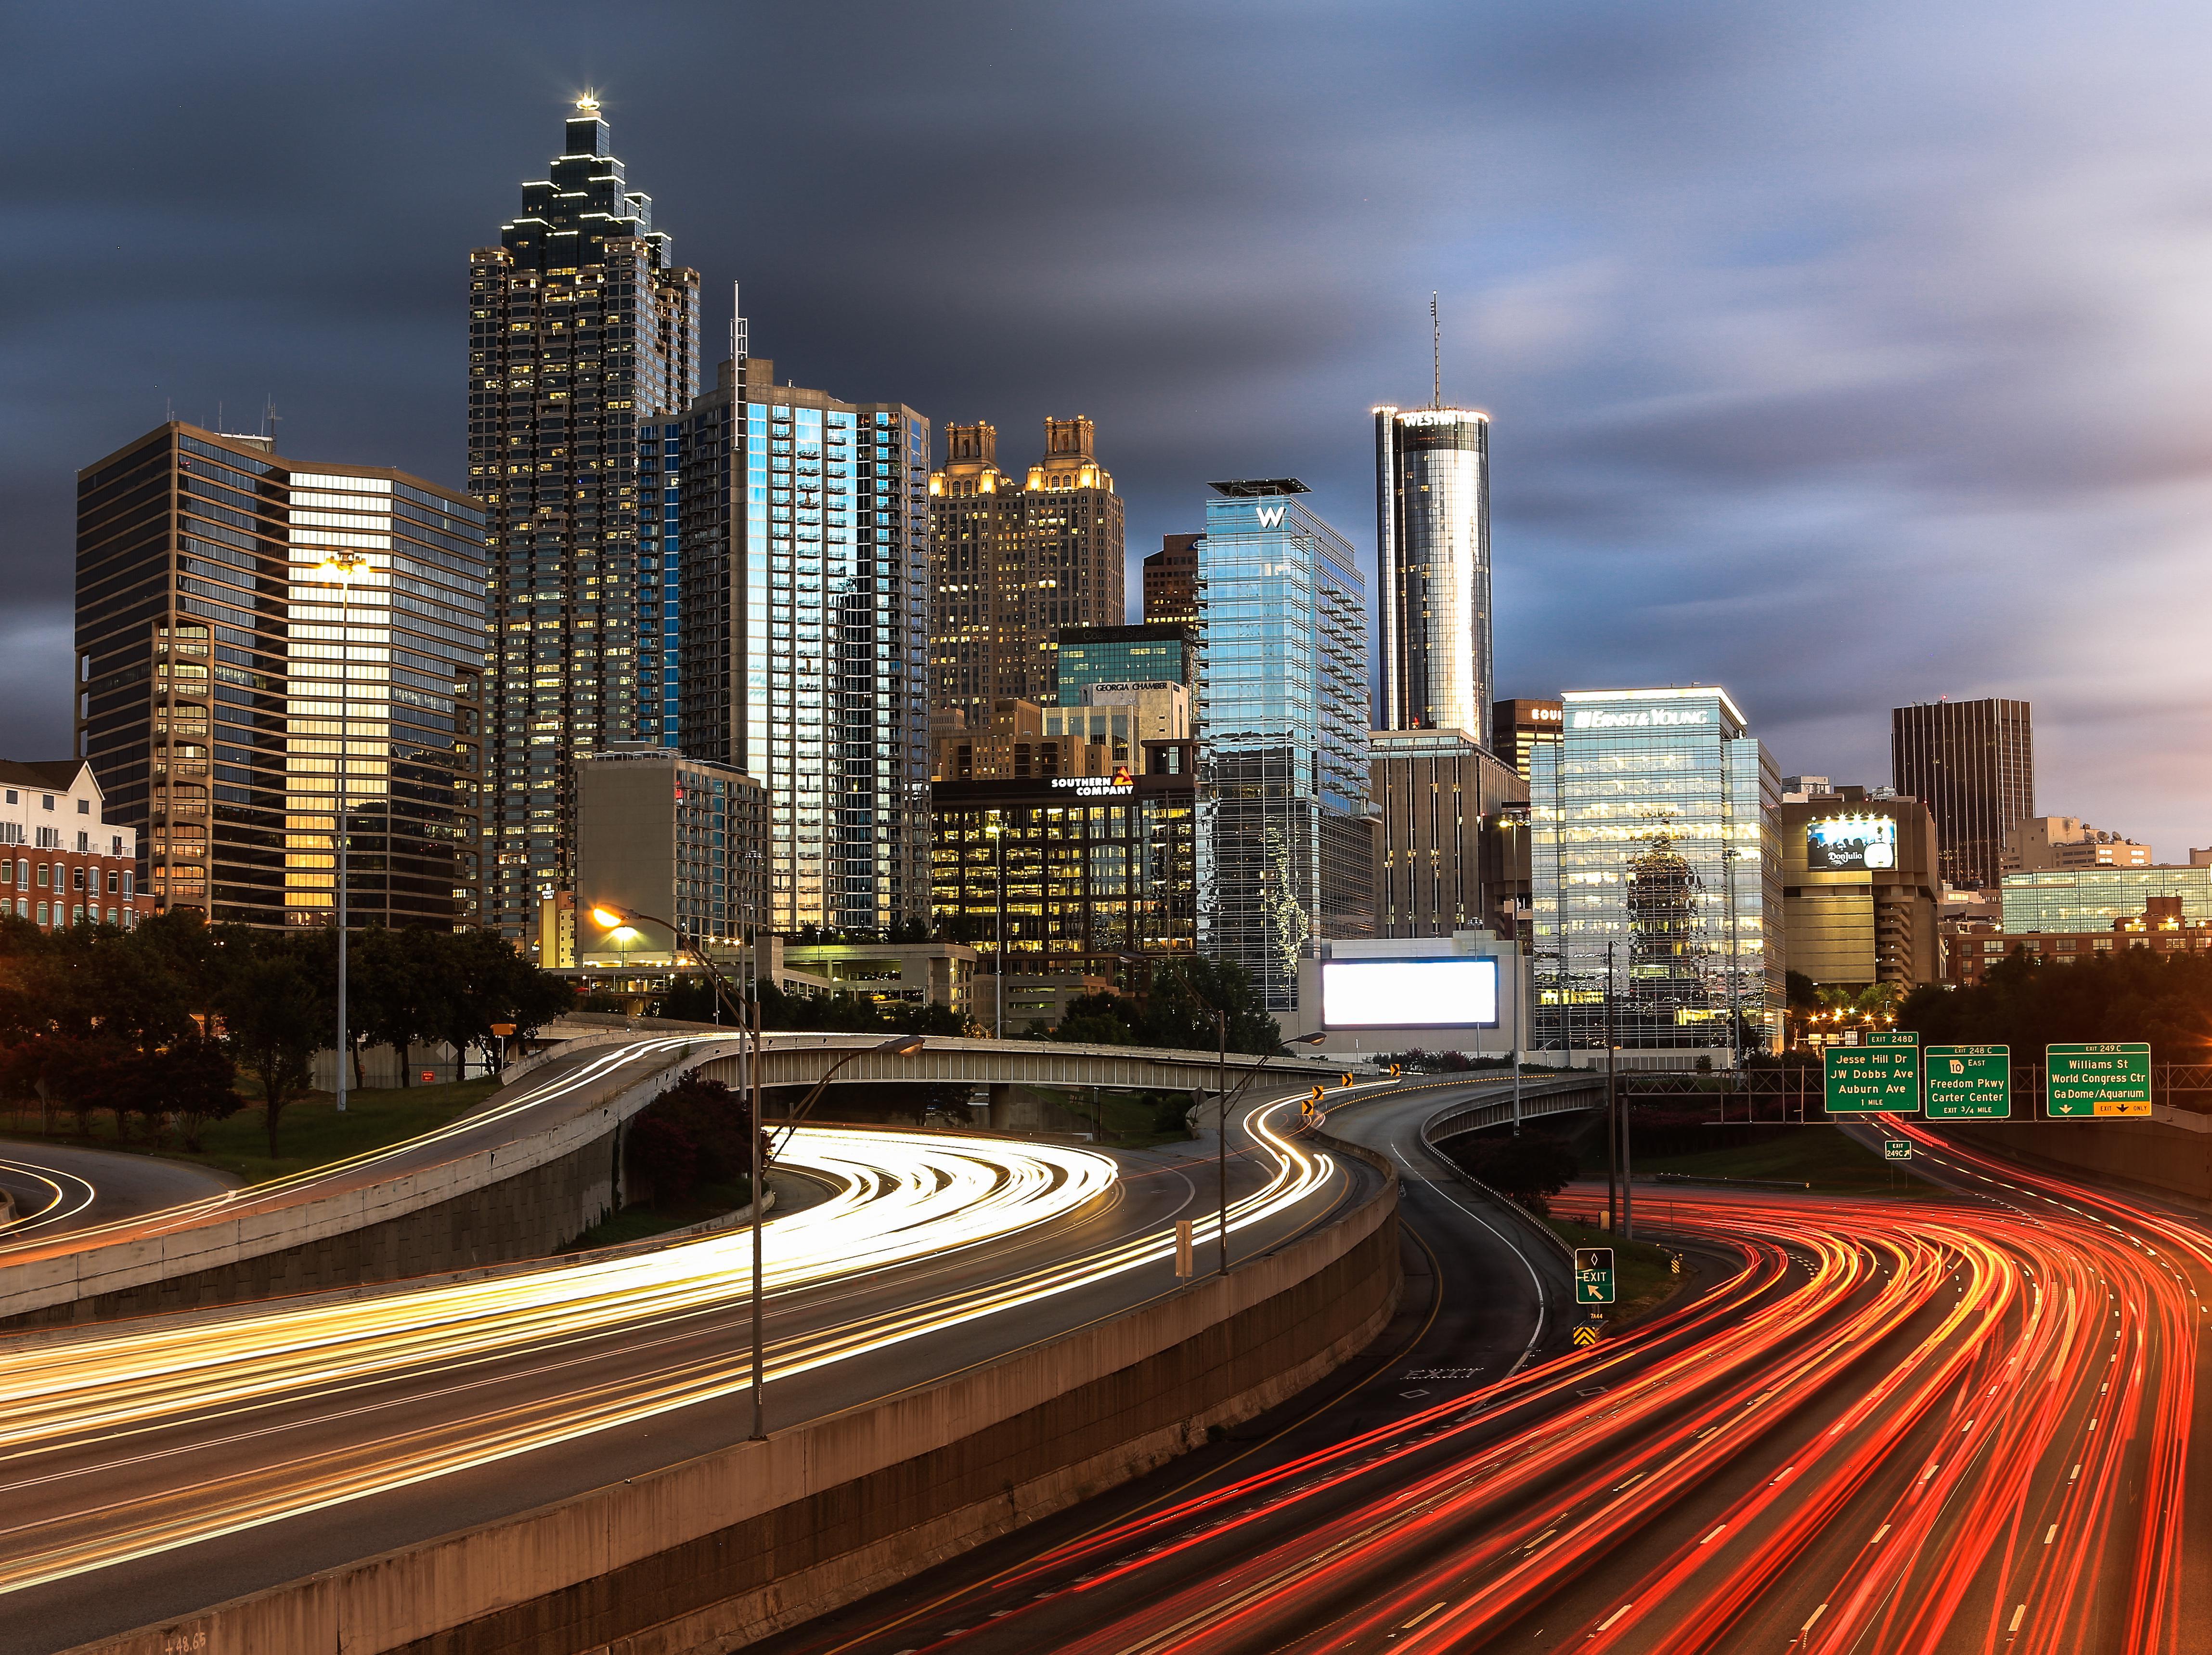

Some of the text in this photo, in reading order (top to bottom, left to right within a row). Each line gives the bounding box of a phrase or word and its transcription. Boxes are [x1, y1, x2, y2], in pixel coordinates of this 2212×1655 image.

[1255, 506, 1286, 529] W
[1084, 629, 1155, 639] Coastal States
[1096, 683, 1129, 692] GEORGIA
[1132, 682, 1167, 691] CHAMBER
[1051, 777, 1111, 788] SOUTHERN
[1076, 786, 1134, 796] COMPANY
[1836, 1054, 1907, 1064] Jesse Hill Dr
[2069, 1059, 2128, 1069] Williams St
[1952, 1064, 1961, 1072] 10
[1830, 1069, 1914, 1079] JW Dobbs Ave
[2052, 1073, 2146, 1085] World Congress Ctr
[1838, 1084, 1906, 1094] Auburn Ave
[1930, 1079, 2004, 1090] Freedom Pkwy
[1932, 1093, 2004, 1102] Carter Center
[1961, 1106, 1974, 1114] 3/4
[1583, 1272, 1606, 1282] EXIT
[1400, 1368, 1484, 1379] EXIT
